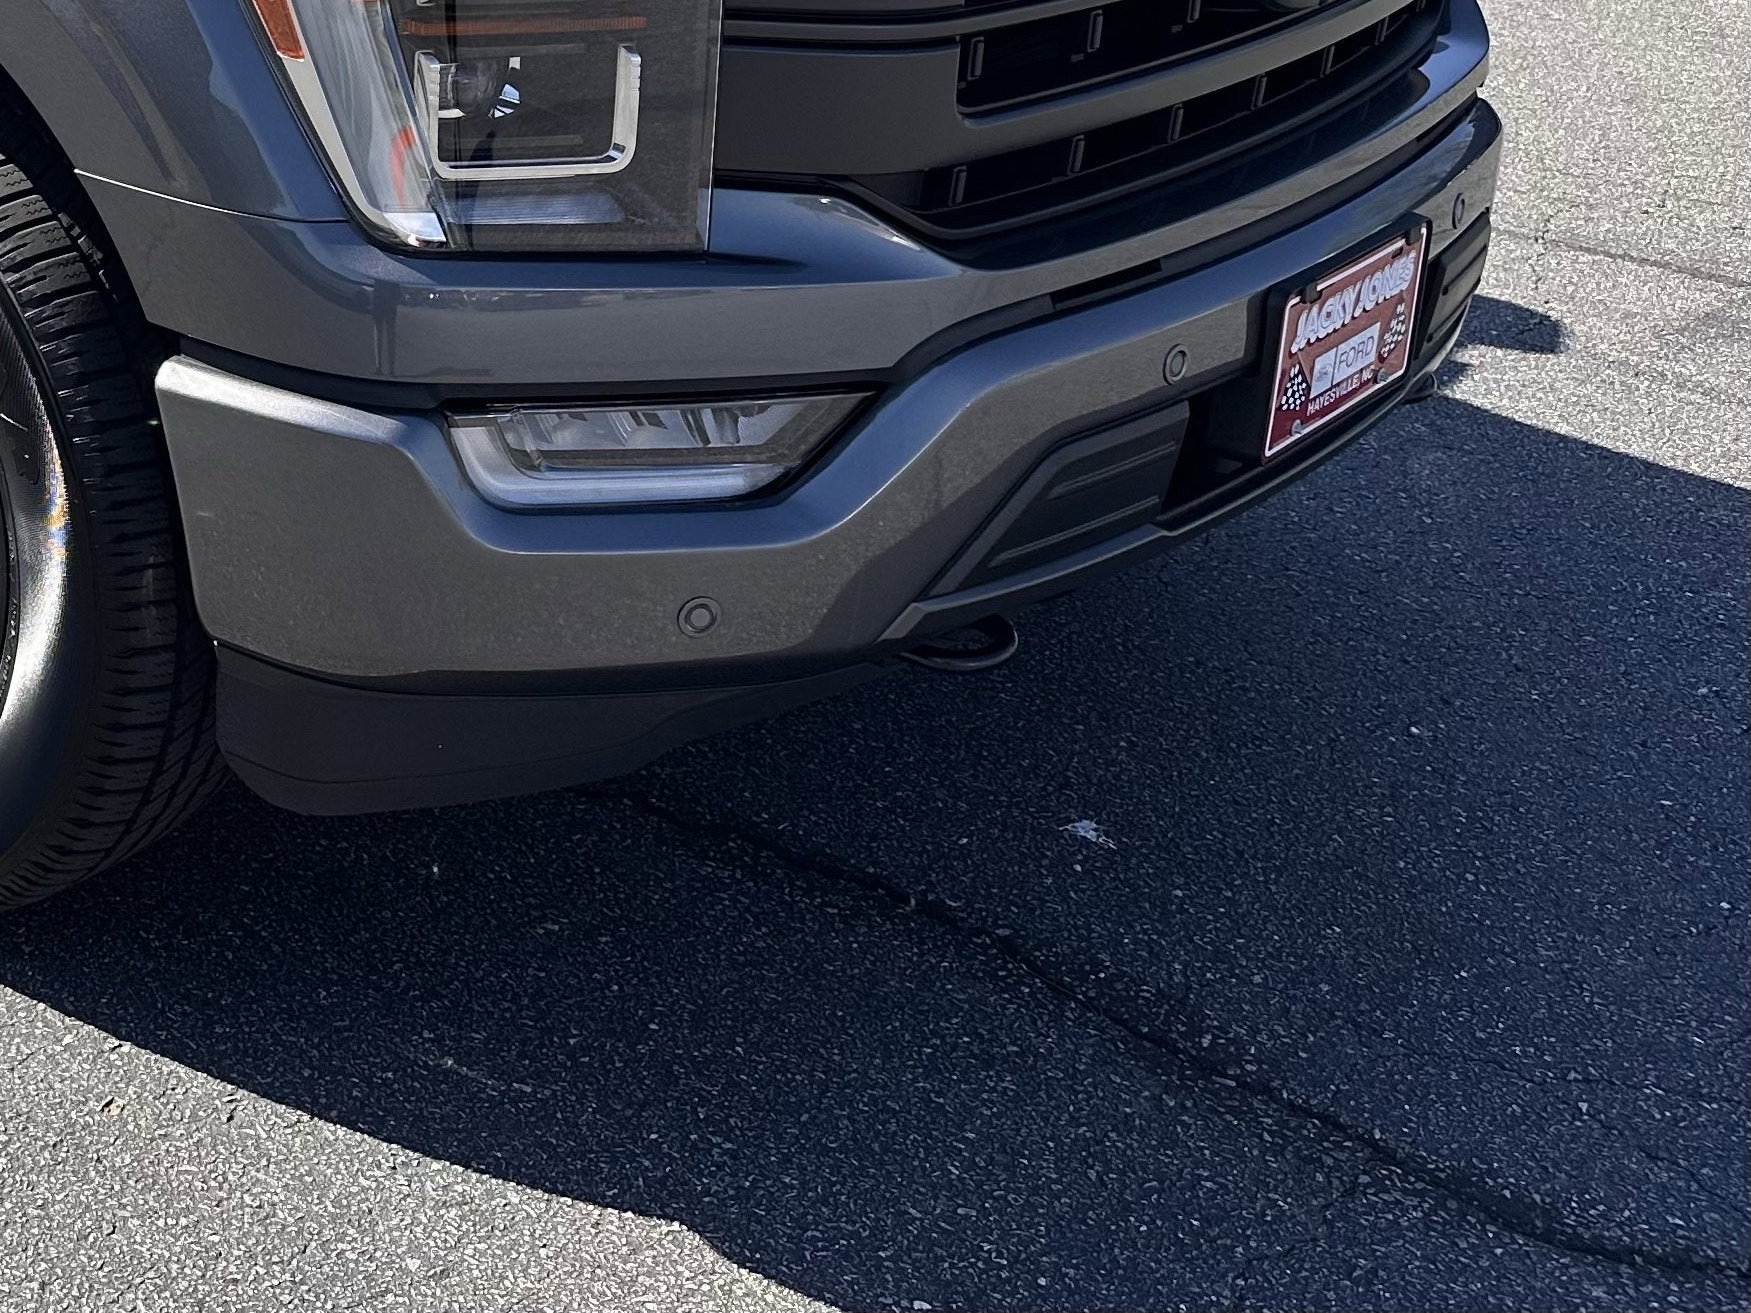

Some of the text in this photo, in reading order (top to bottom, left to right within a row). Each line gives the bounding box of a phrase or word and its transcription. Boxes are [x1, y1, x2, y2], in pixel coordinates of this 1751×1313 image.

[1290, 249, 1417, 354] JACKY JONES
[1337, 335, 1375, 373] FORD
